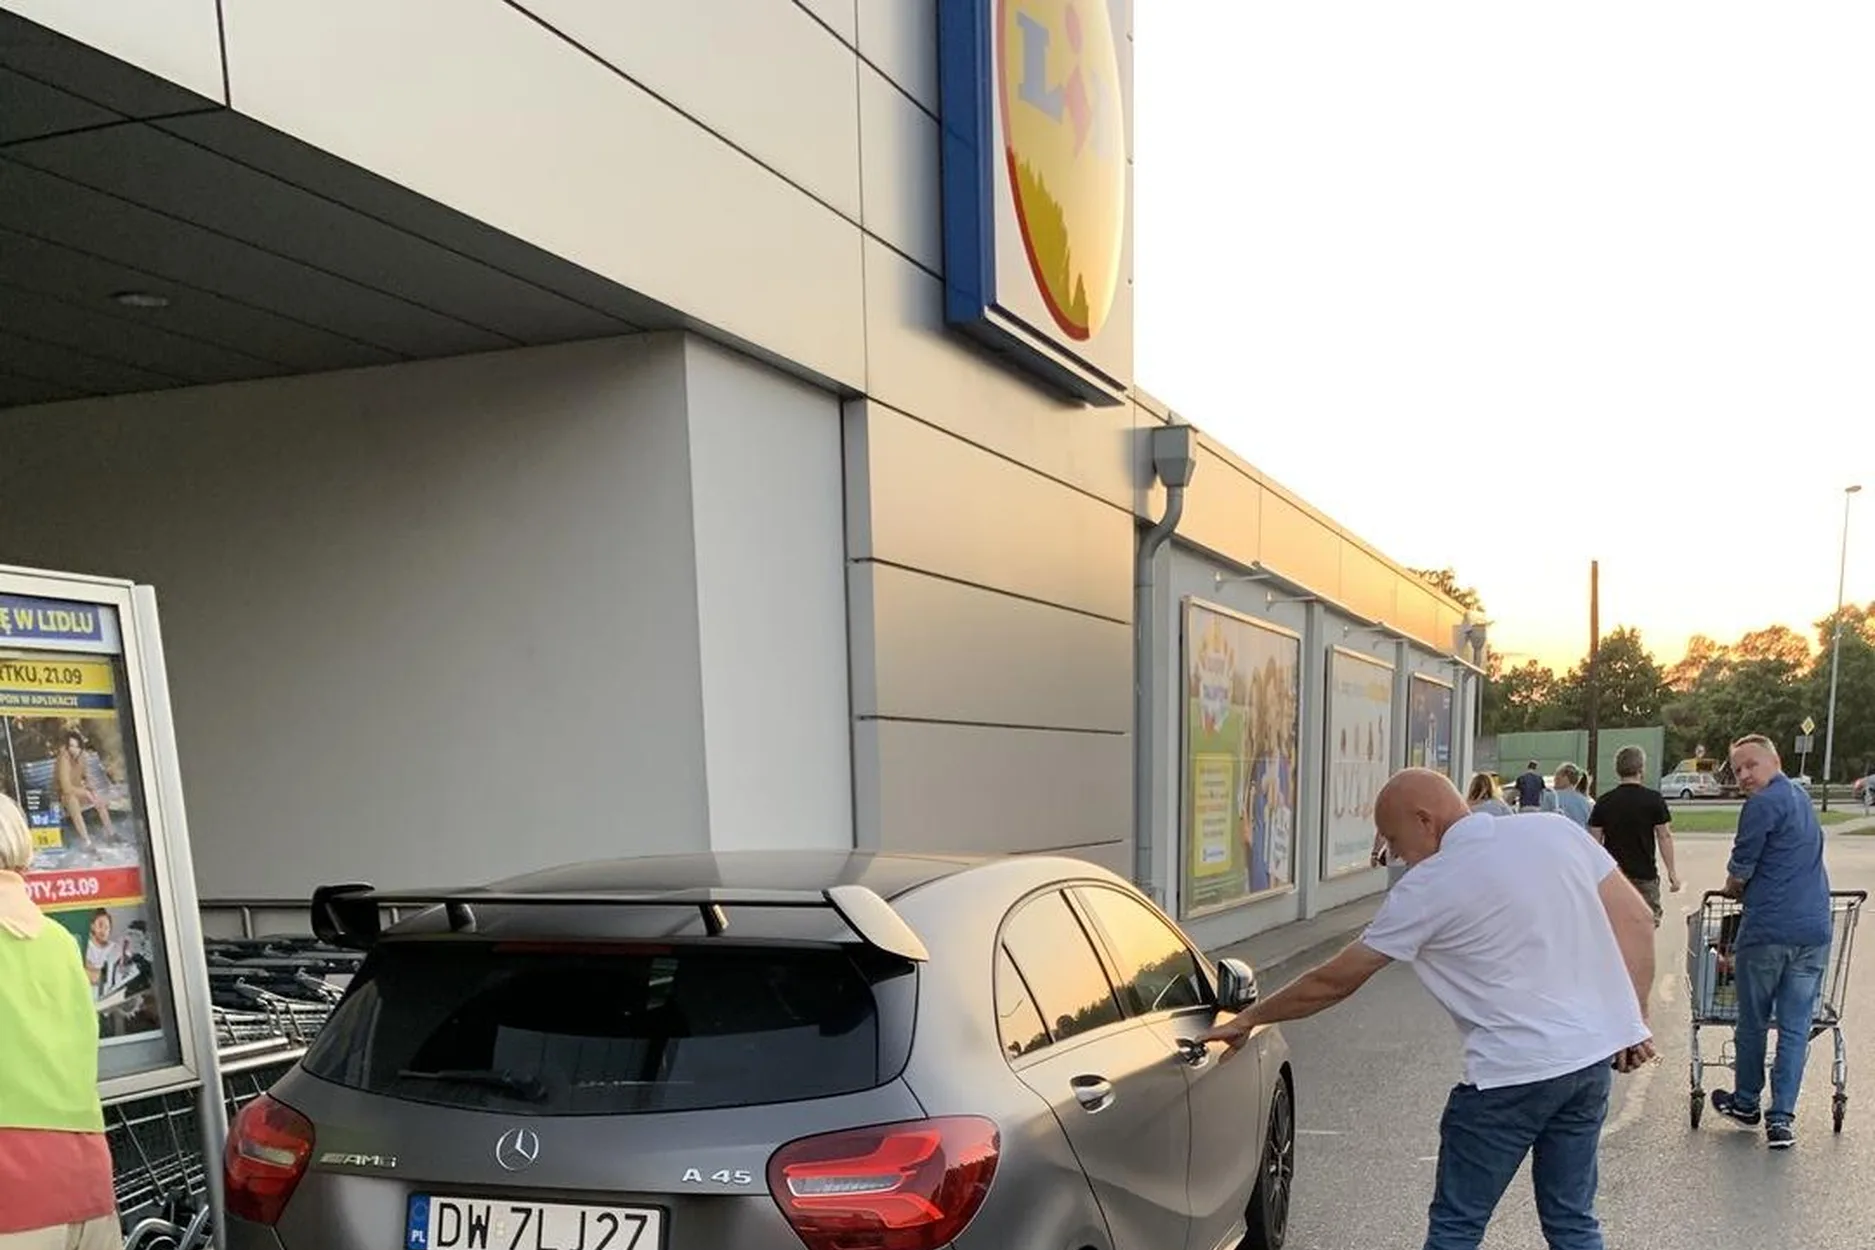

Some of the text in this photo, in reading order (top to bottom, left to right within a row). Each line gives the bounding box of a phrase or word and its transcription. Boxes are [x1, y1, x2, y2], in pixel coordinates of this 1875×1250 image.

[13, 608, 34, 630] W
[37, 609, 94, 634] LIDLU
[43, 666, 82, 685] 21.09
[57, 877, 98, 897] 23.09
[682, 1168, 752, 1185] A 45
[437, 1201, 491, 1250] DW
[411, 1228, 426, 1243] PL
